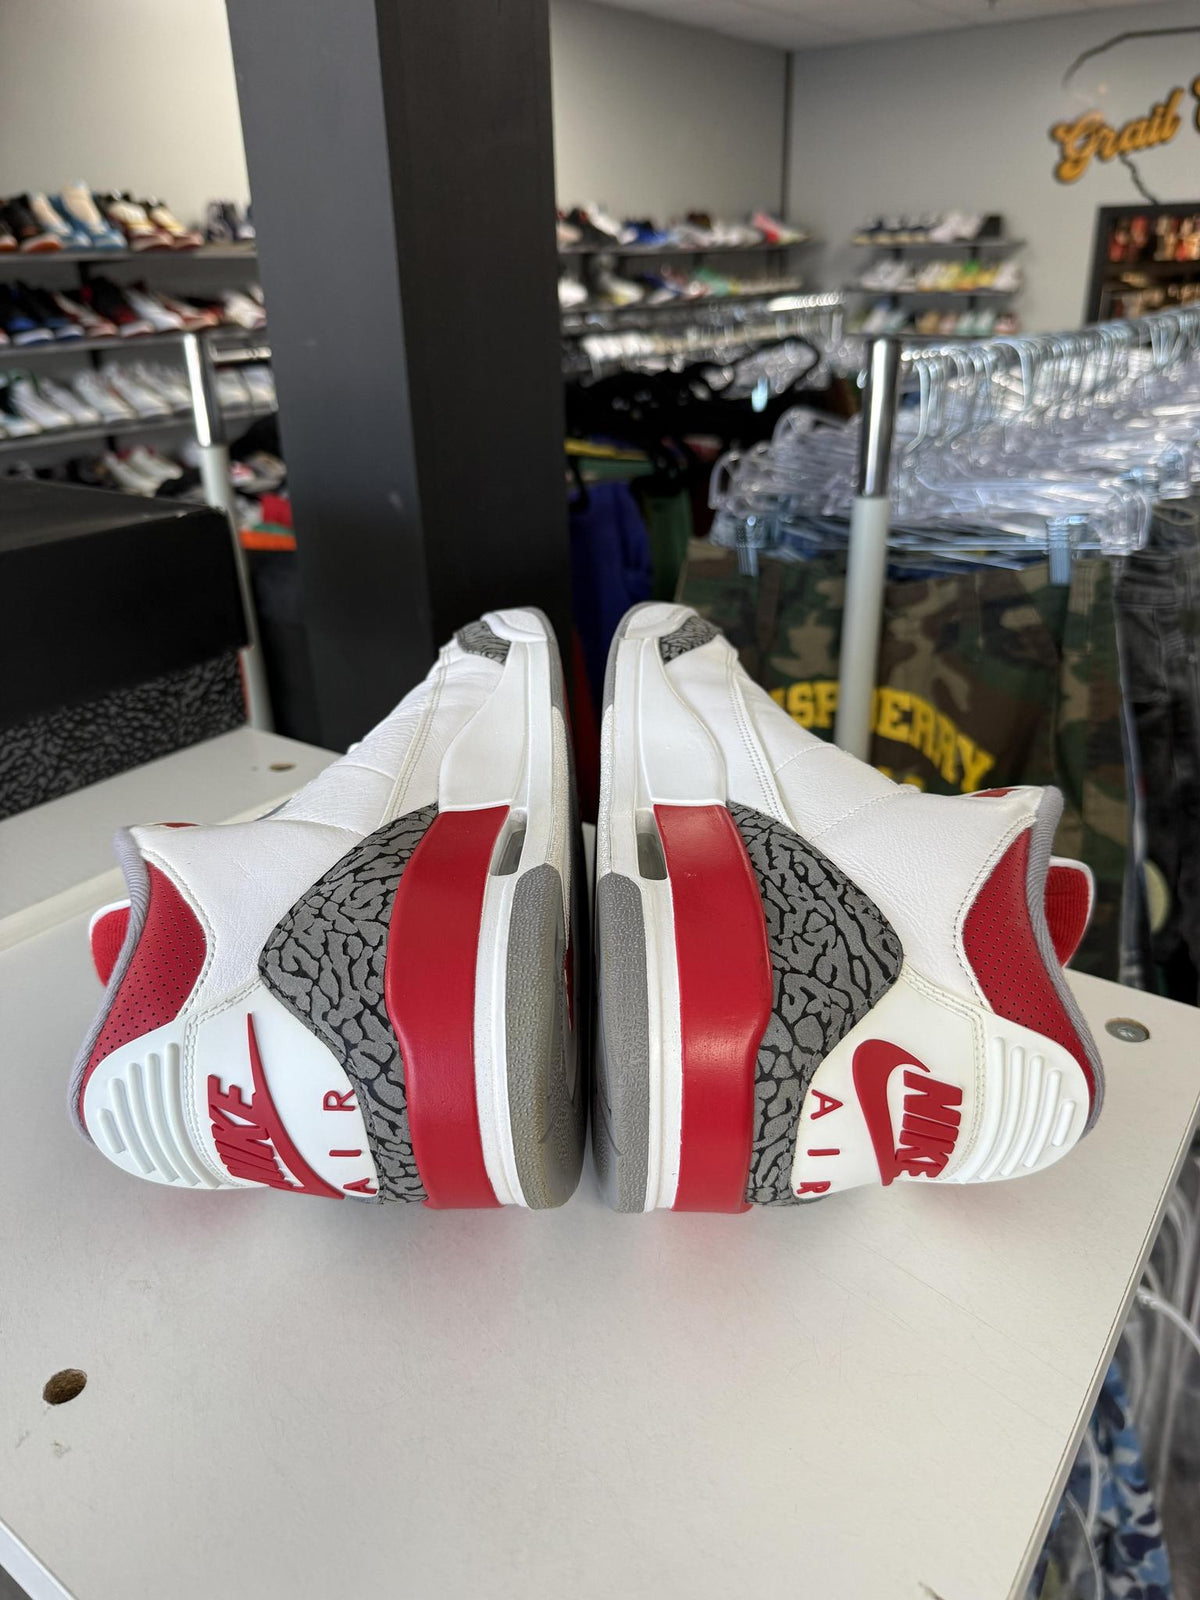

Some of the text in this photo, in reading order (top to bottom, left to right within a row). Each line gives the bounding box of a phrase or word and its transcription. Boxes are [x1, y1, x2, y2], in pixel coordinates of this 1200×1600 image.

[1049, 86, 1184, 184] Grail
[208, 1074, 295, 1189] NIKE
[323, 1089, 378, 1195] AIR
[796, 1089, 844, 1195] AIR
[894, 1070, 963, 1179] NIKE
